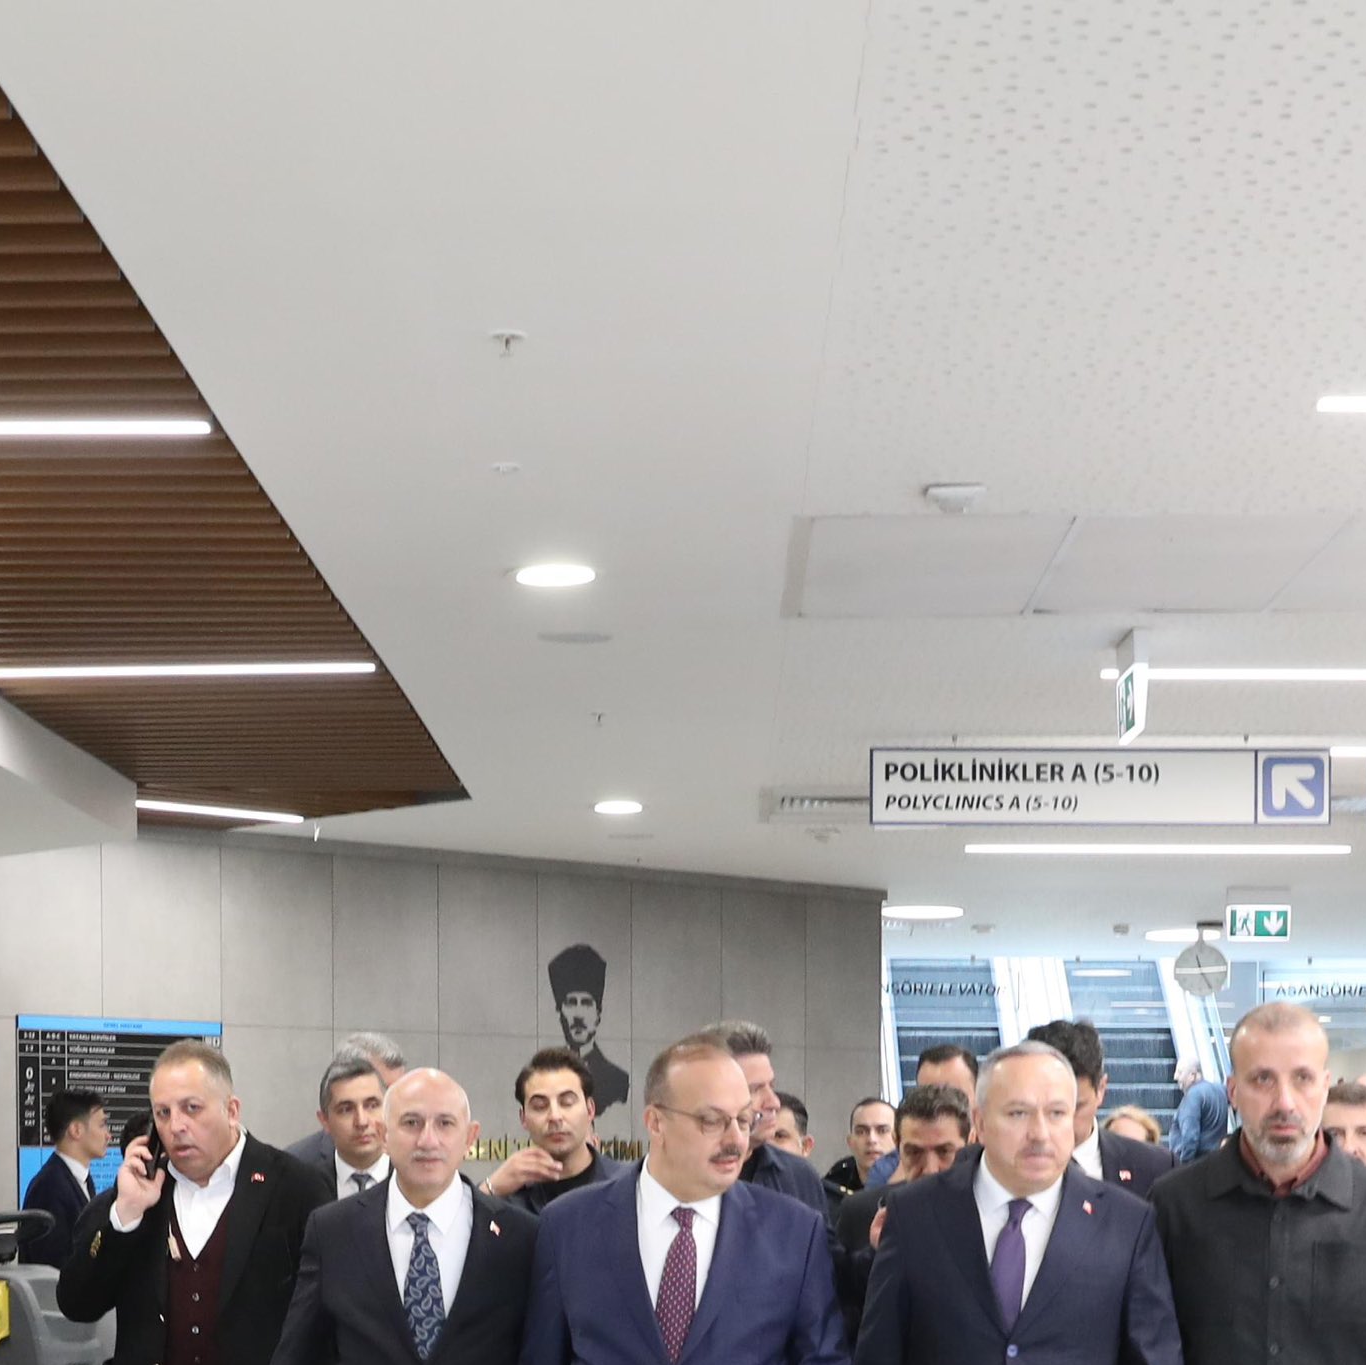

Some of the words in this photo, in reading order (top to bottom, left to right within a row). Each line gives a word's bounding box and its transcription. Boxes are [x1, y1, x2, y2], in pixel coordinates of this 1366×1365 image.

[884, 758, 1065, 782] POLİKLİNİKLER
[1071, 763, 1087, 782] A
[1094, 762, 1160, 786] (5-10)
[885, 793, 1004, 811] POLYCLINICS
[1009, 794, 1021, 811] A
[1025, 794, 1079, 813] (5-10)
